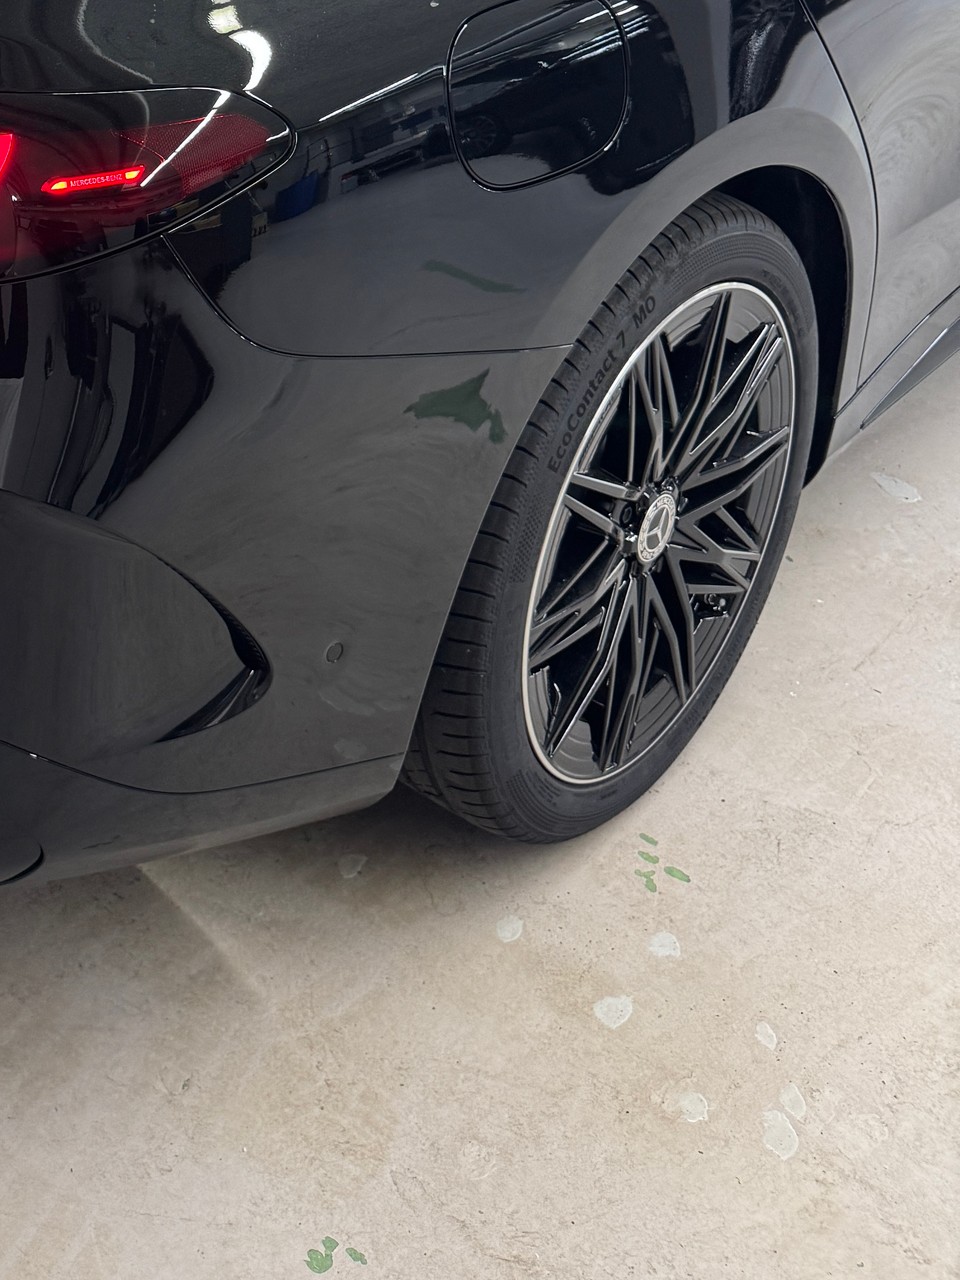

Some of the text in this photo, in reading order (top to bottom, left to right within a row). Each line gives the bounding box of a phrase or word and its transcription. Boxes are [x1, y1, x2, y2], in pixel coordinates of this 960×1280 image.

[70, 173, 123, 188] MERCEDES-BENZ
[547, 295, 656, 473] EcoContact 7 MO
